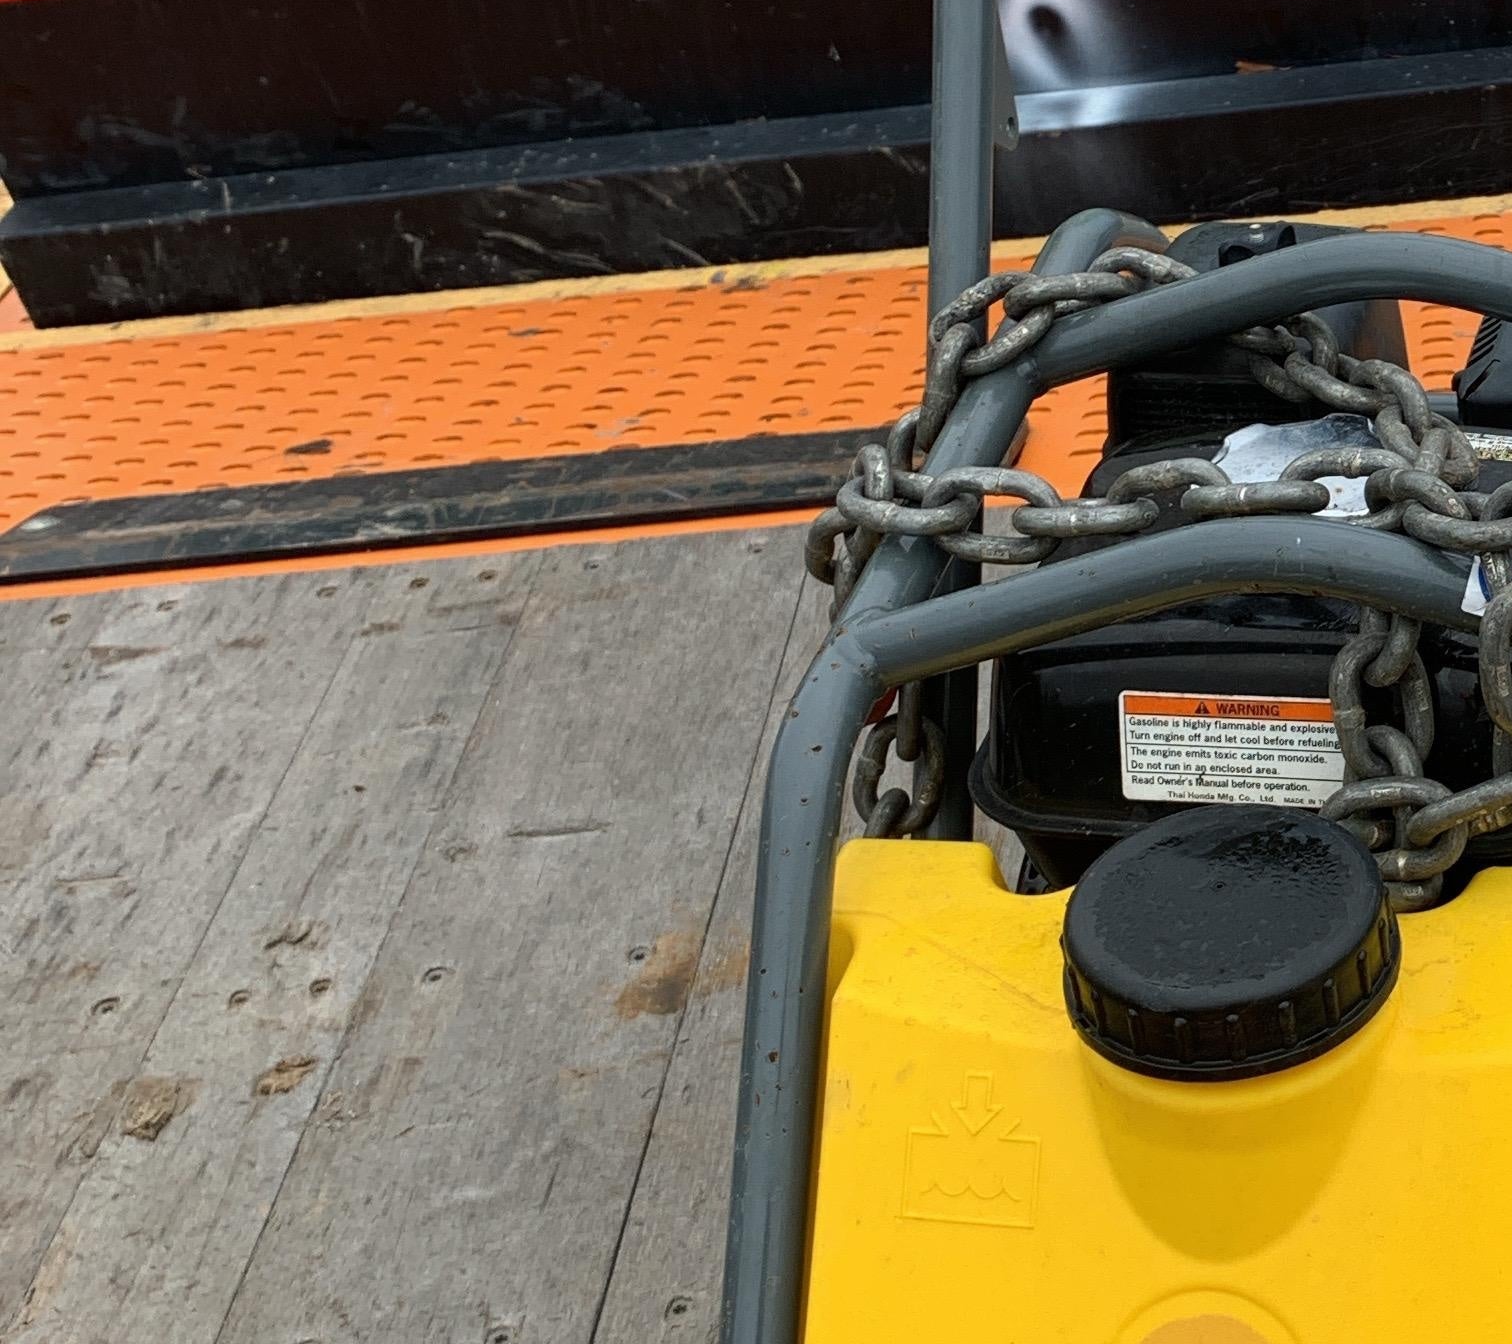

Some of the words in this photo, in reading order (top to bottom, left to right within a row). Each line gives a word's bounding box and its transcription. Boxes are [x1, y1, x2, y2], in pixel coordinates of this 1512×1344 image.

[1216, 703, 1280, 717] WARNING
[1129, 716, 1169, 727] Gasoline
[1172, 718, 1180, 728] is
[1182, 719, 1212, 731] highly
[1214, 720, 1266, 731] flammable
[1269, 722, 1287, 732] and
[1130, 731, 1151, 740] Turn
[1153, 732, 1185, 743] engine
[1188, 732, 1202, 742] off
[1204, 734, 1222, 743] and
[1224, 734, 1237, 743] let
[1240, 735, 1260, 745] cool
[1263, 736, 1295, 746] before
[1131, 746, 1148, 756] The
[1150, 747, 1182, 758] engine
[1185, 748, 1212, 759] emits
[1214, 750, 1238, 760] toxic
[1240, 751, 1275, 761] carbon
[1277, 753, 1328, 764] monoxide.
[1131, 760, 1144, 770] Do
[1146, 761, 1162, 771] not
[1164, 763, 1180, 771] run
[1183, 762, 1192, 772] in
[1194, 764, 1207, 773] an
[1209, 764, 1252, 774] enclosed
[1255, 766, 1281, 775] area.
[1131, 775, 1155, 785] Read
[1157, 776, 1193, 787] Owner's
[1195, 777, 1229, 788] Manual
[1231, 779, 1261, 789] before
[1263, 781, 1311, 792] operation.
[1167, 790, 1186, 799] Thai
[1188, 791, 1215, 800] Honda
[1283, 797, 1304, 805] MADE
